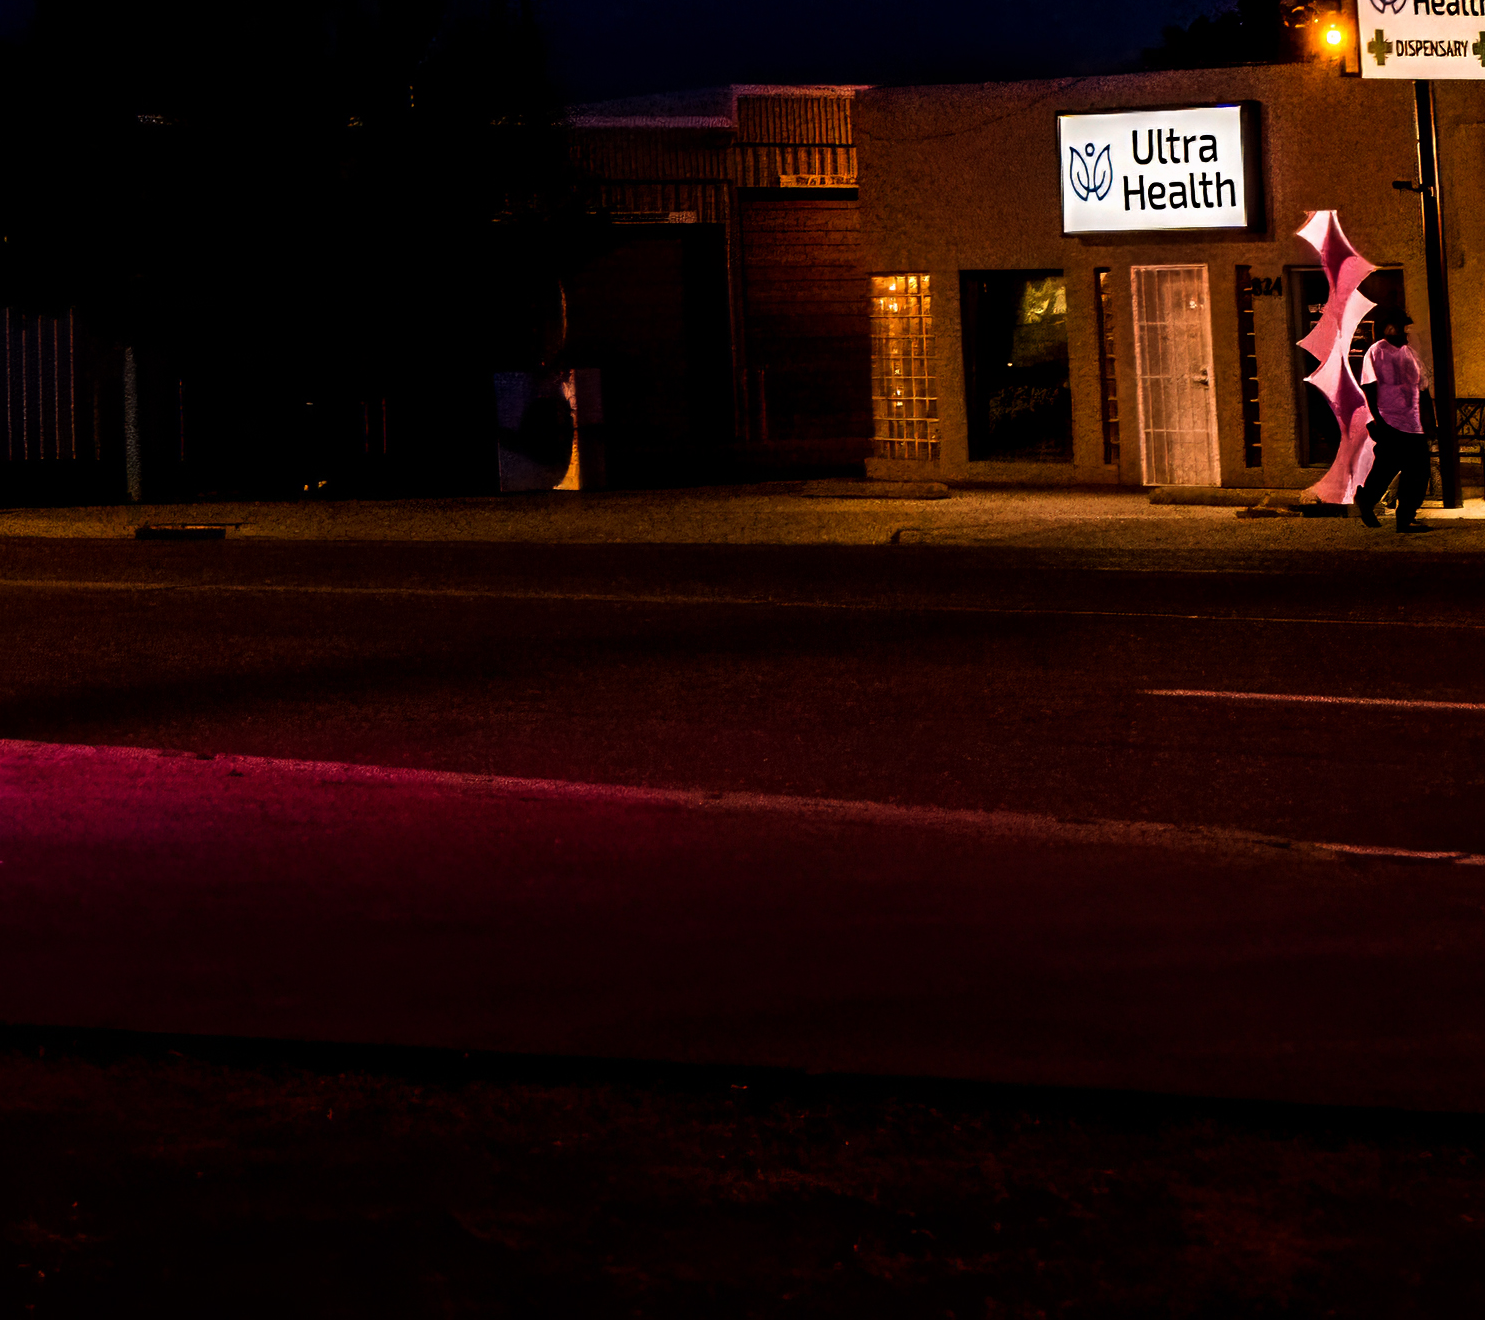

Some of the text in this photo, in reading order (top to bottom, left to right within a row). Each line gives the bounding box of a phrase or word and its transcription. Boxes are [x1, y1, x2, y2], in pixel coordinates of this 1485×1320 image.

[1395, 40, 1469, 58] DISPENSARY
[1132, 128, 1219, 165] Ultra
[1123, 172, 1237, 211] Health
